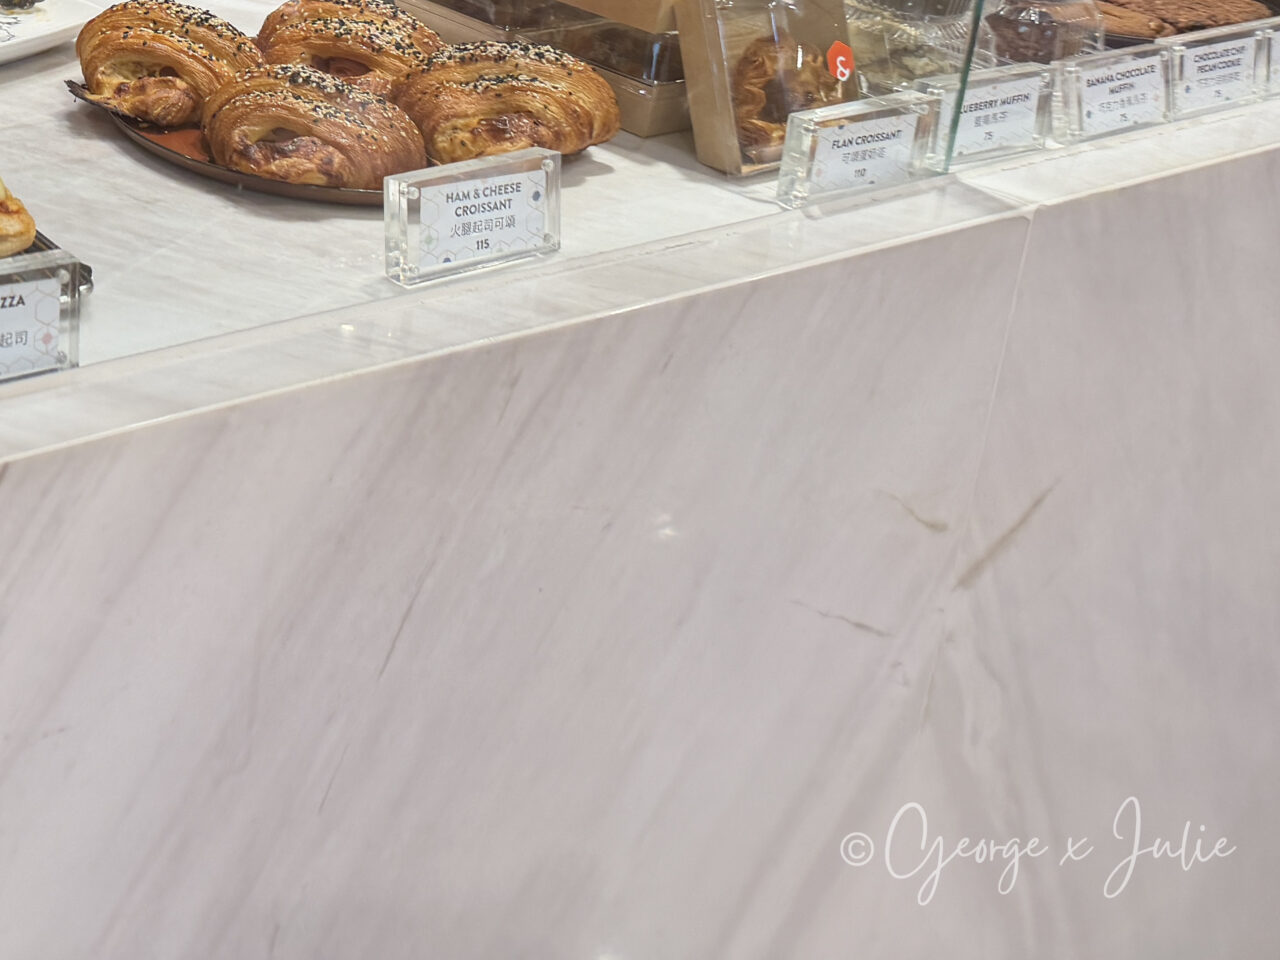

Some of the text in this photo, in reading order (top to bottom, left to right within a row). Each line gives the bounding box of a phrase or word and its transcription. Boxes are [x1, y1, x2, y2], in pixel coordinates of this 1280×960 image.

[1115, 64, 1157, 81] CHOCOLATE
[1000, 93, 1031, 107] MUFFIN
[832, 129, 902, 150] FLAN CROISSANT
[446, 182, 522, 204] HAM & CHEESE
[455, 199, 513, 217] CROISSANT
[450, 215, 516, 238] 火腿起司可頌
[476, 239, 490, 250] 115
